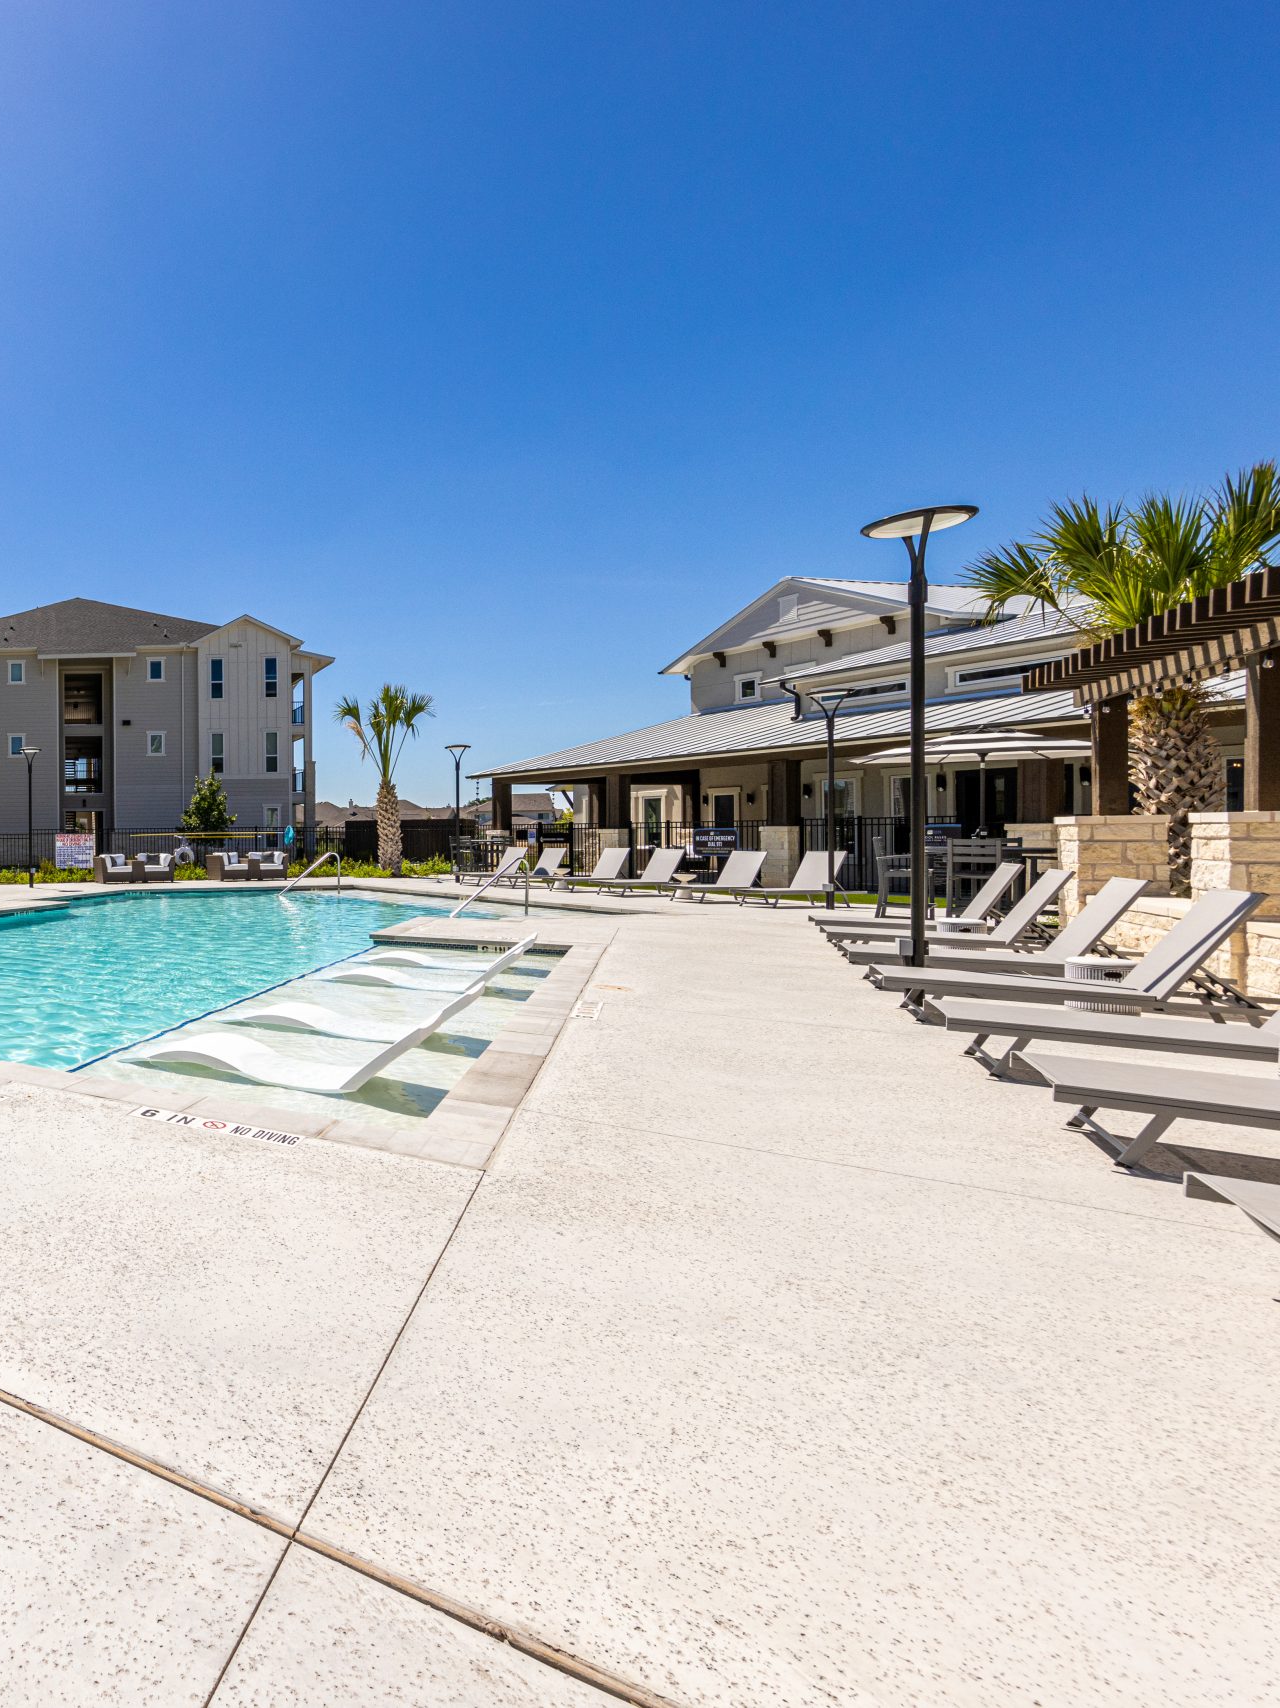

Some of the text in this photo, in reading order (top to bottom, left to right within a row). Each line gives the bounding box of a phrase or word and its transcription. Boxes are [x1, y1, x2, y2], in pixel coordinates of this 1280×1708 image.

[140, 1109, 300, 1146] 6 IN NO DIVING
